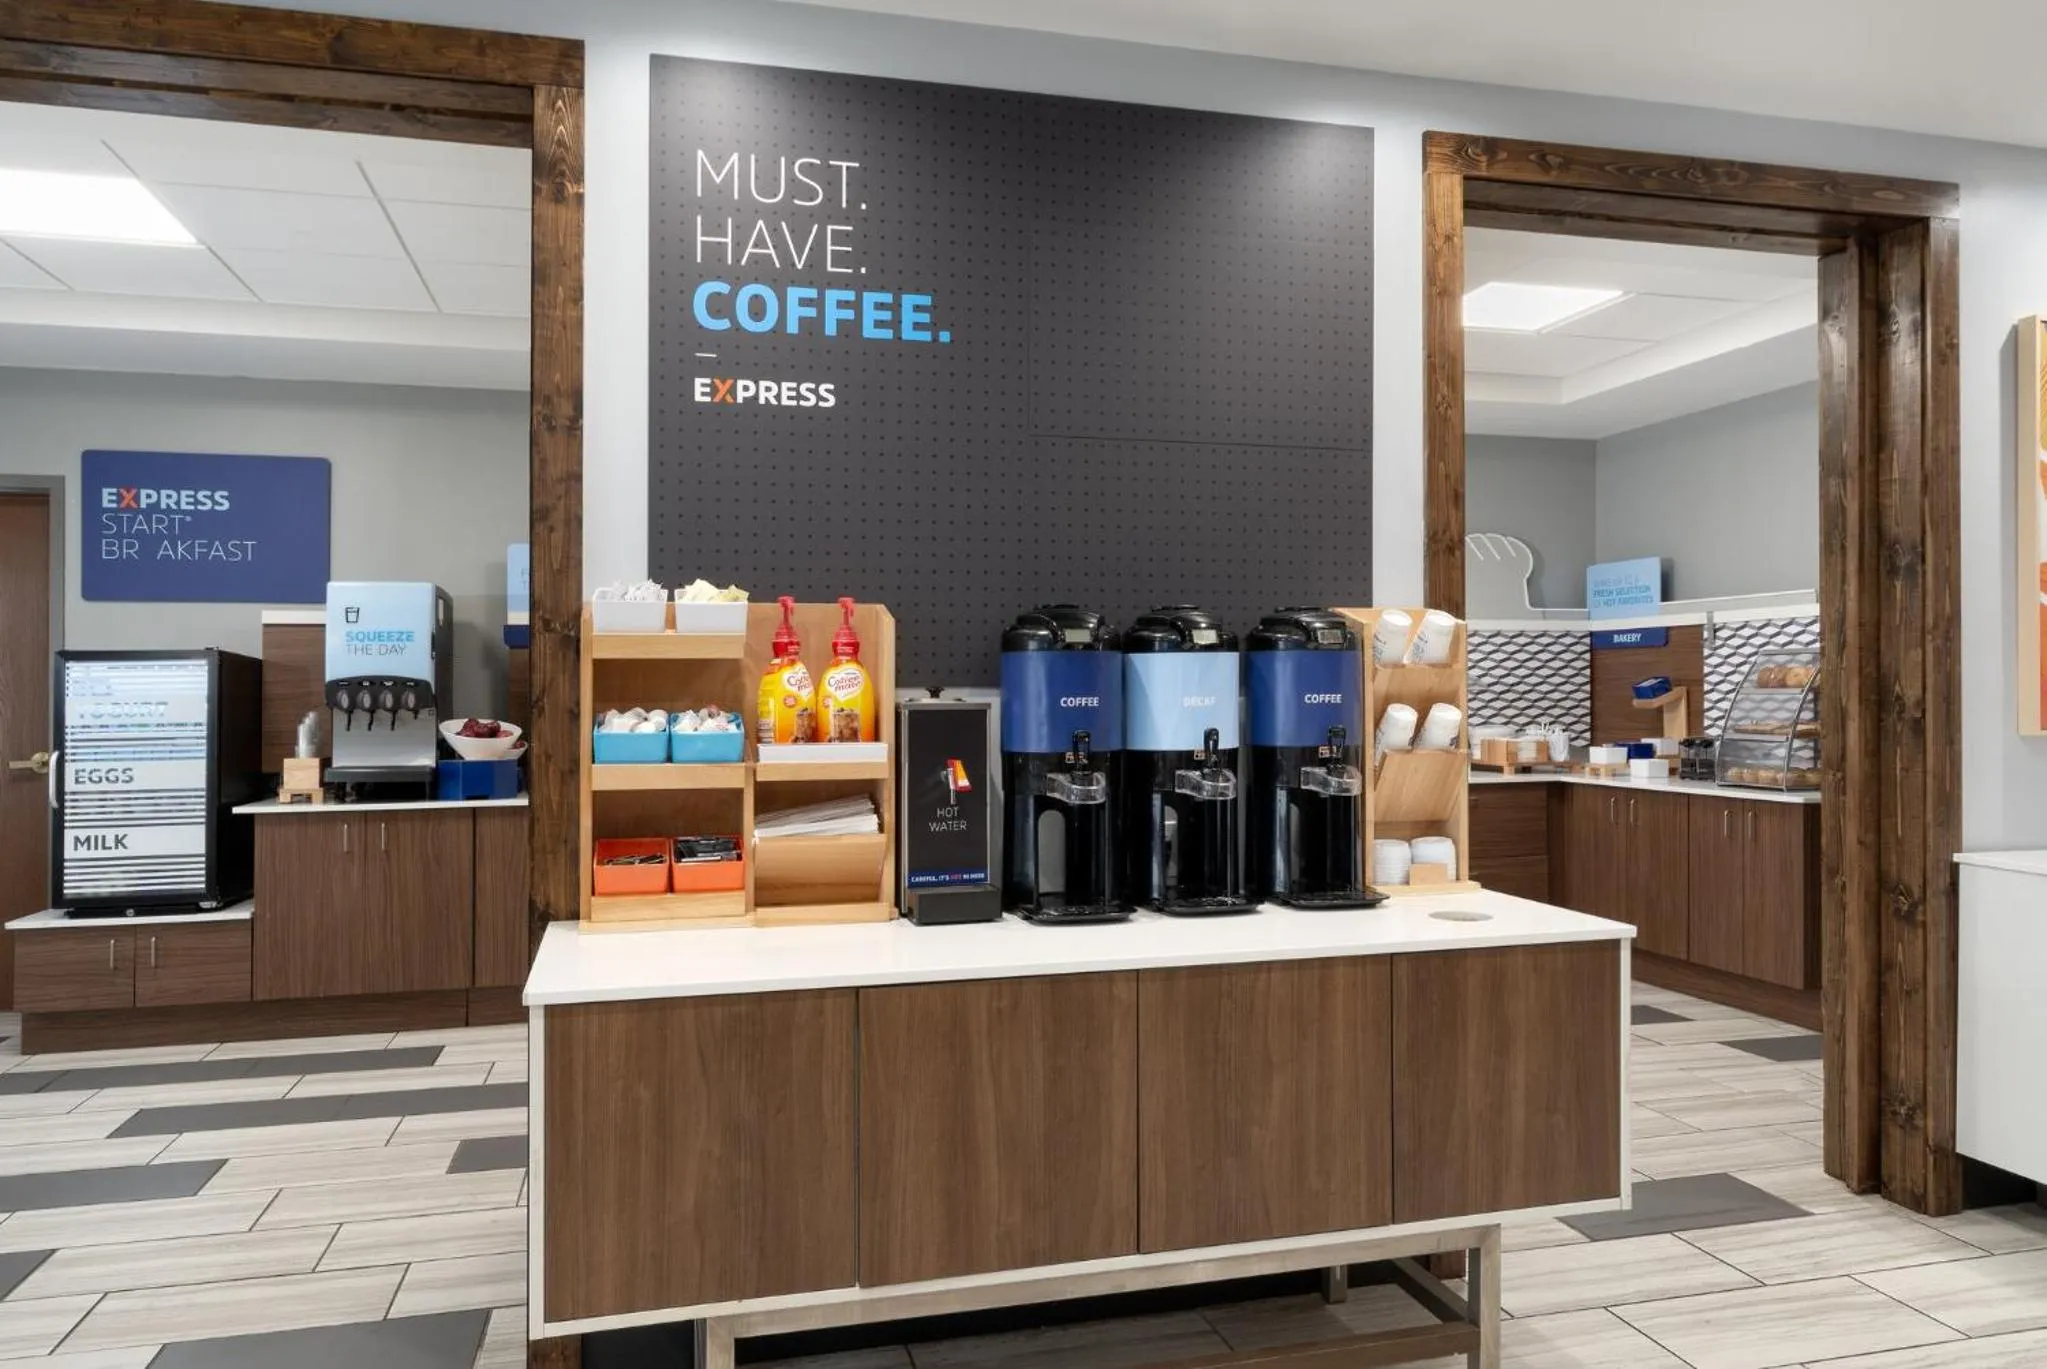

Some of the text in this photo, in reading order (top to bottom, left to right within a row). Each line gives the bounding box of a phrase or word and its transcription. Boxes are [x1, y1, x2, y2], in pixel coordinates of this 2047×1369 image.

[696, 149, 867, 211] MUST.
[696, 214, 867, 274] HAVE.
[692, 280, 952, 343] COFFEE.
[694, 377, 836, 408] EXPRESS
[101, 487, 231, 511] EXPRESS
[345, 631, 415, 643] SQUEEZE
[1613, 633, 1642, 643] BAKERY
[346, 643, 373, 656] THE
[1059, 696, 1100, 708] COFFEE
[1304, 693, 1343, 704] COFFEE
[74, 767, 135, 785] EGGS
[936, 806, 960, 818] HOT
[928, 819, 967, 832] WATER
[73, 833, 129, 851] MILK
